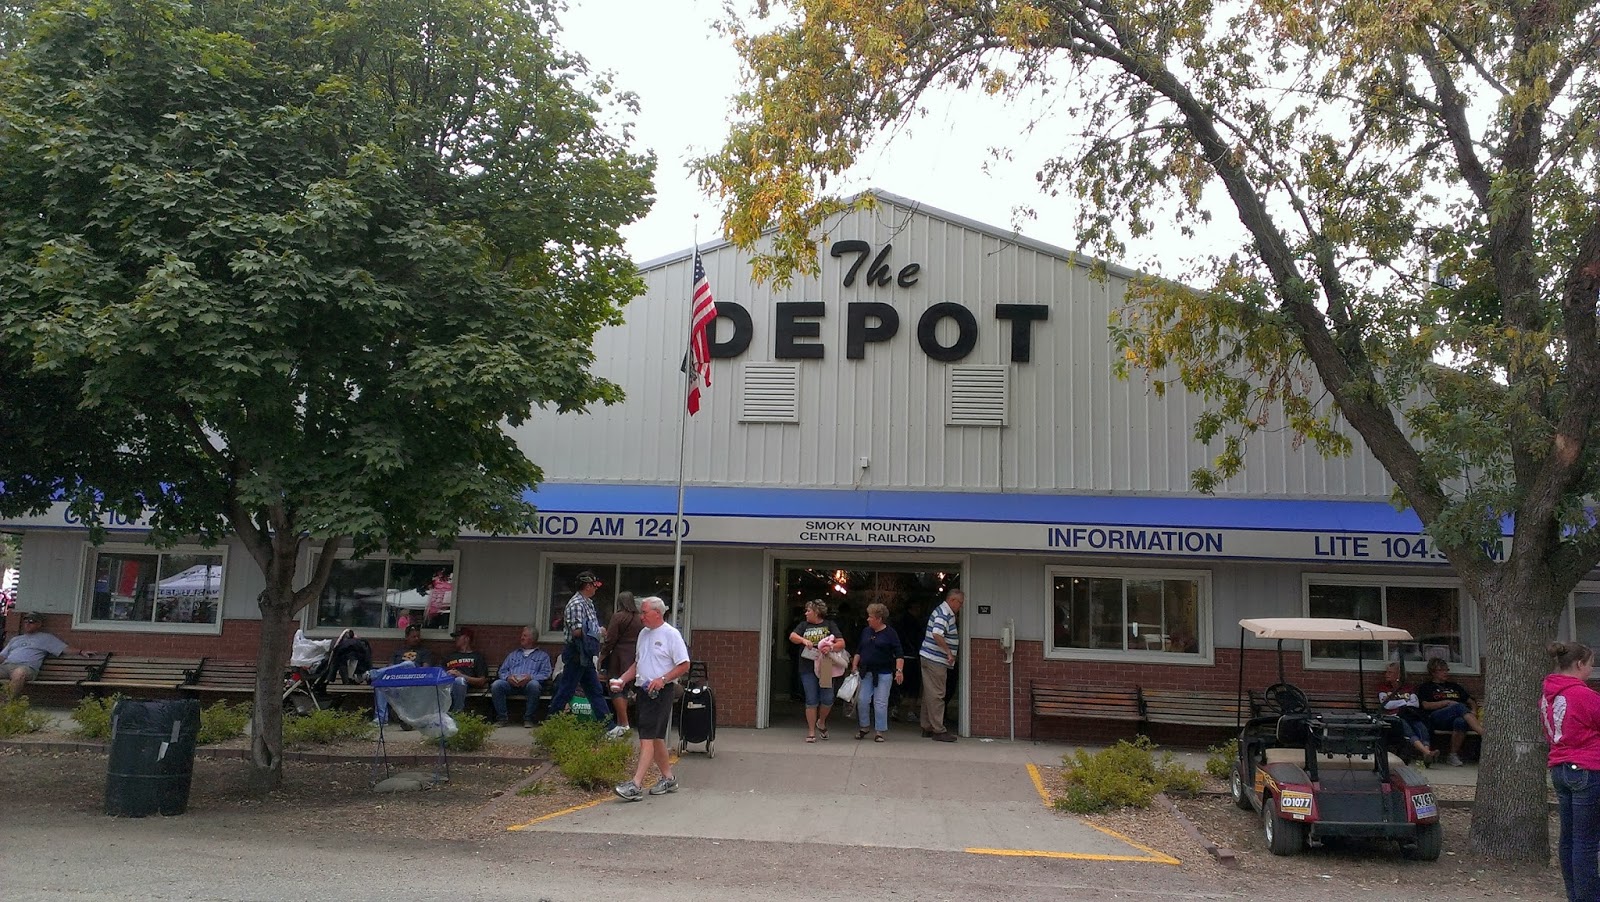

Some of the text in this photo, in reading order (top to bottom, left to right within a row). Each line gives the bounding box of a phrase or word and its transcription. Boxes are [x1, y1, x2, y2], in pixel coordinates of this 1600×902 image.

[830, 239, 921, 288] The
[705, 301, 1049, 362] DEPOT
[588, 517, 625, 536] AM
[634, 518, 690, 538] 1240
[799, 531, 936, 544] CENTRAL RAILROAD
[805, 521, 931, 532] SMOKY MOUNTAIN
[1048, 527, 1223, 553] INFORMATION
[1314, 535, 1369, 557] LITE
[1381, 537, 1448, 560] 104.
